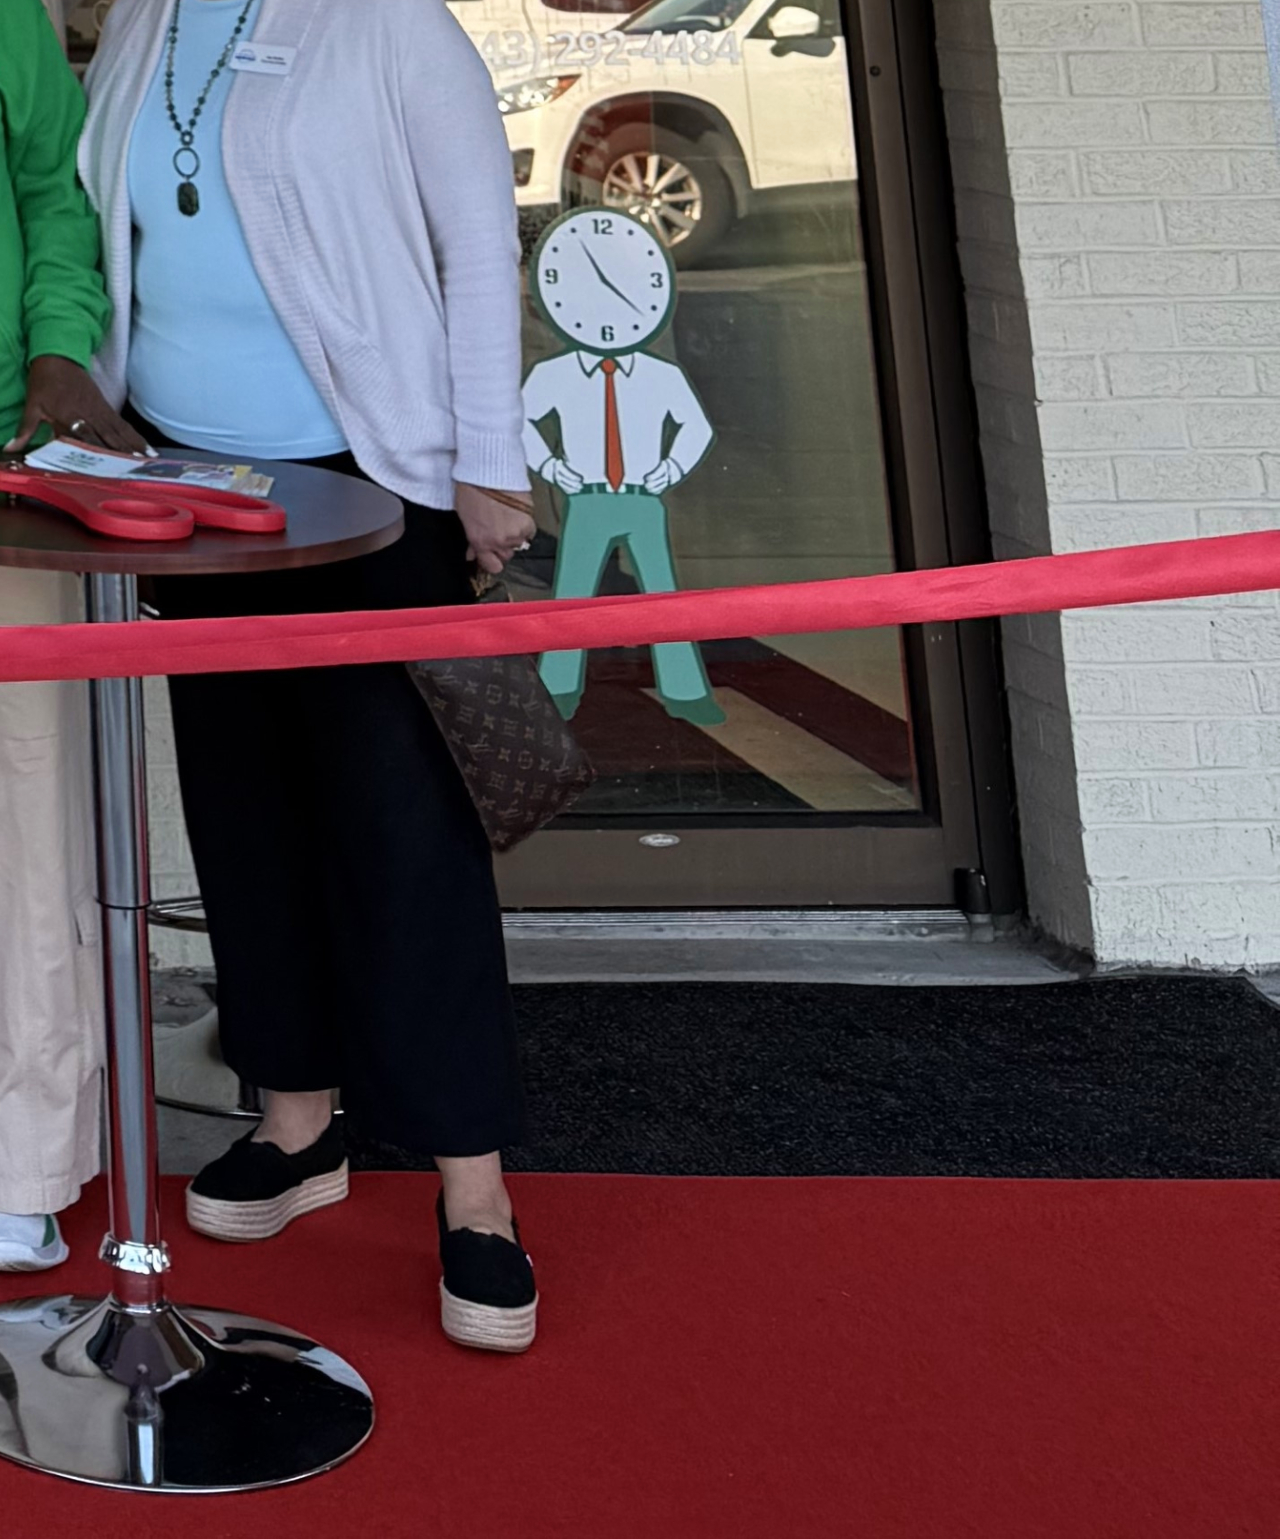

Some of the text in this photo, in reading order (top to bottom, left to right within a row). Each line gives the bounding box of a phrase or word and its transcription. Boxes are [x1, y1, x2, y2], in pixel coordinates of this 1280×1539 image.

[481, 28, 741, 74] 43) 292-4484
[591, 219, 613, 235] 12
[545, 268, 558, 284] 9
[650, 272, 663, 289] 3
[601, 325, 614, 342] 6
